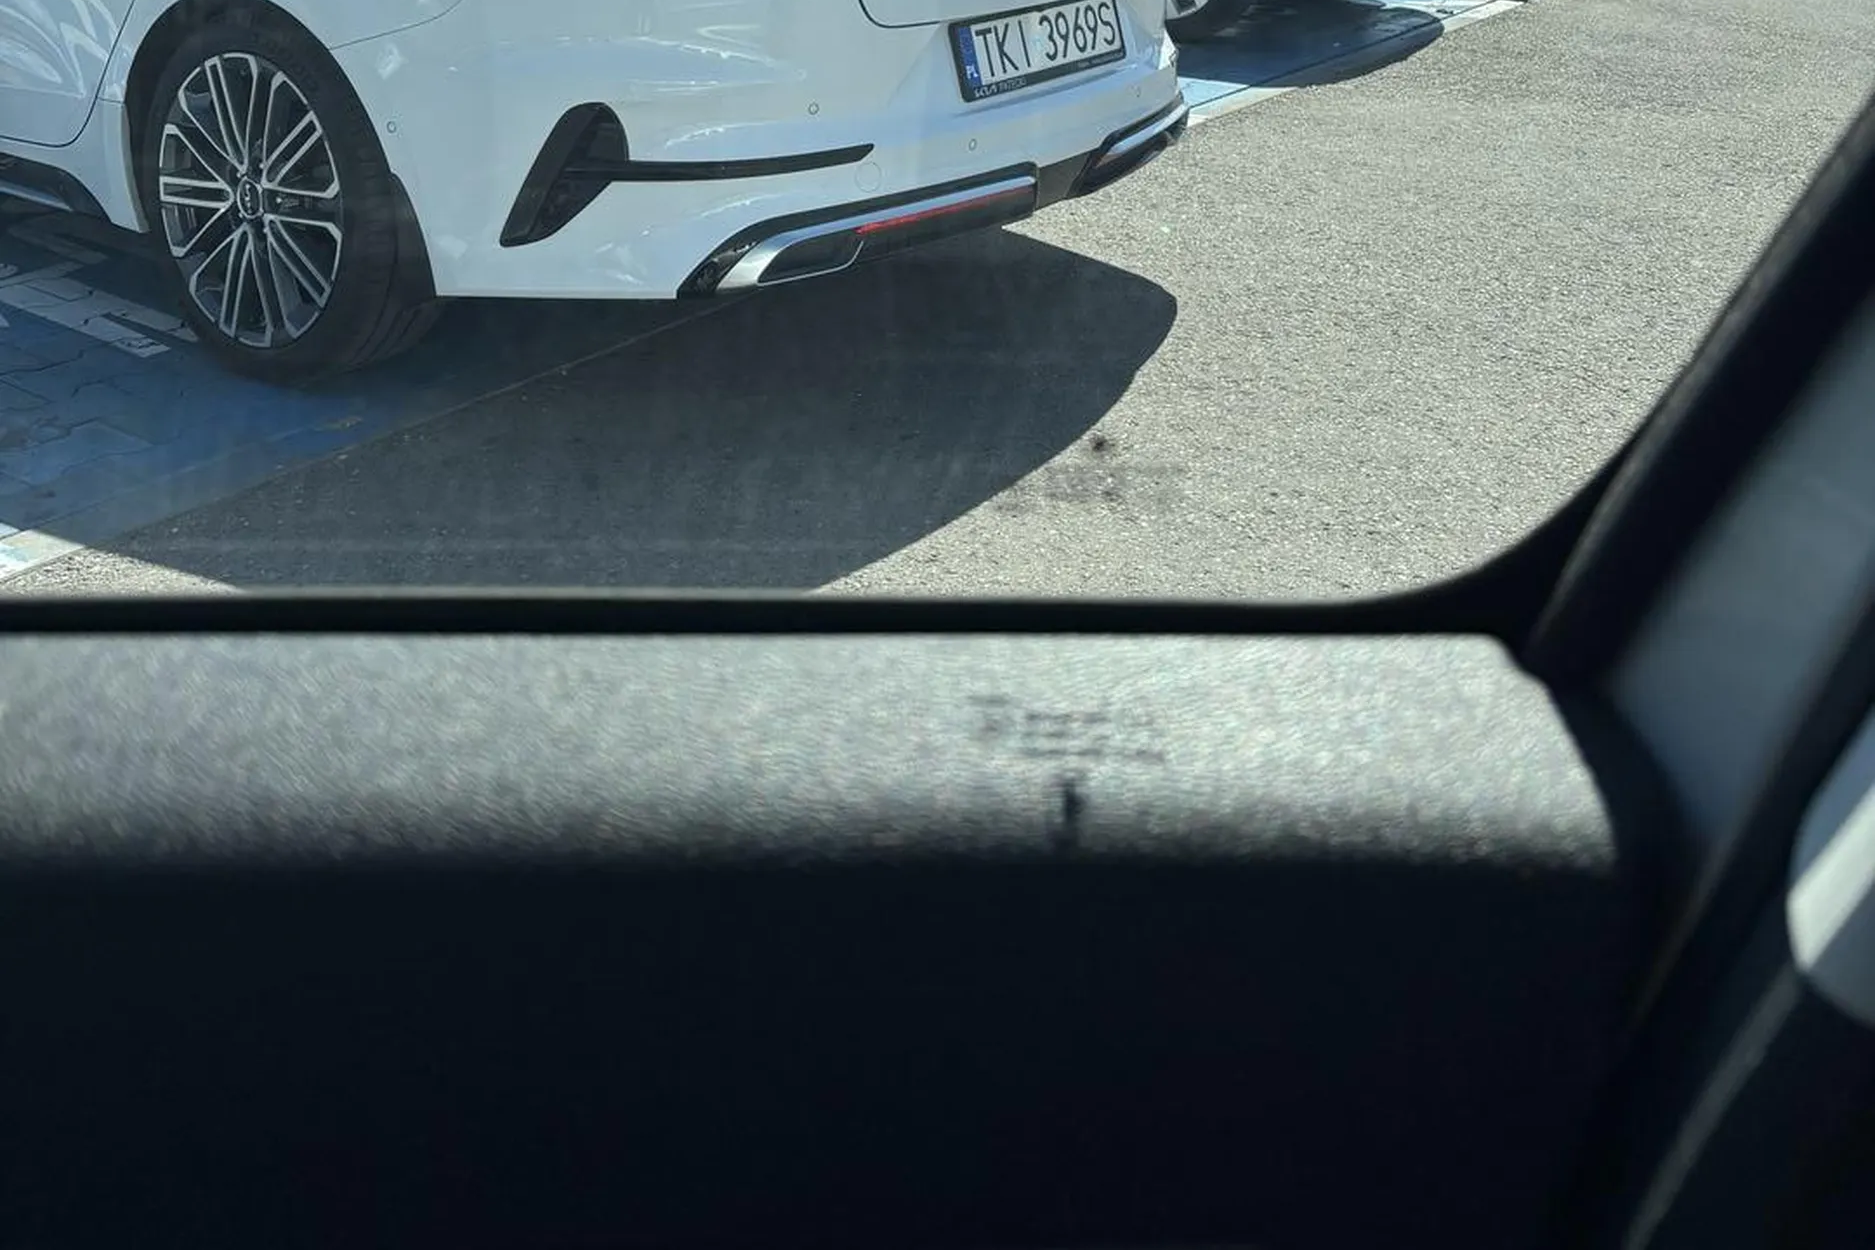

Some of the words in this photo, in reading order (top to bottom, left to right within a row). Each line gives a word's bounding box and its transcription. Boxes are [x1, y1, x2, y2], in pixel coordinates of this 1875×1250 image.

[975, 20, 1031, 77] TKI
[1039, 1, 1116, 61] 3969S
[965, 64, 979, 79] PL
